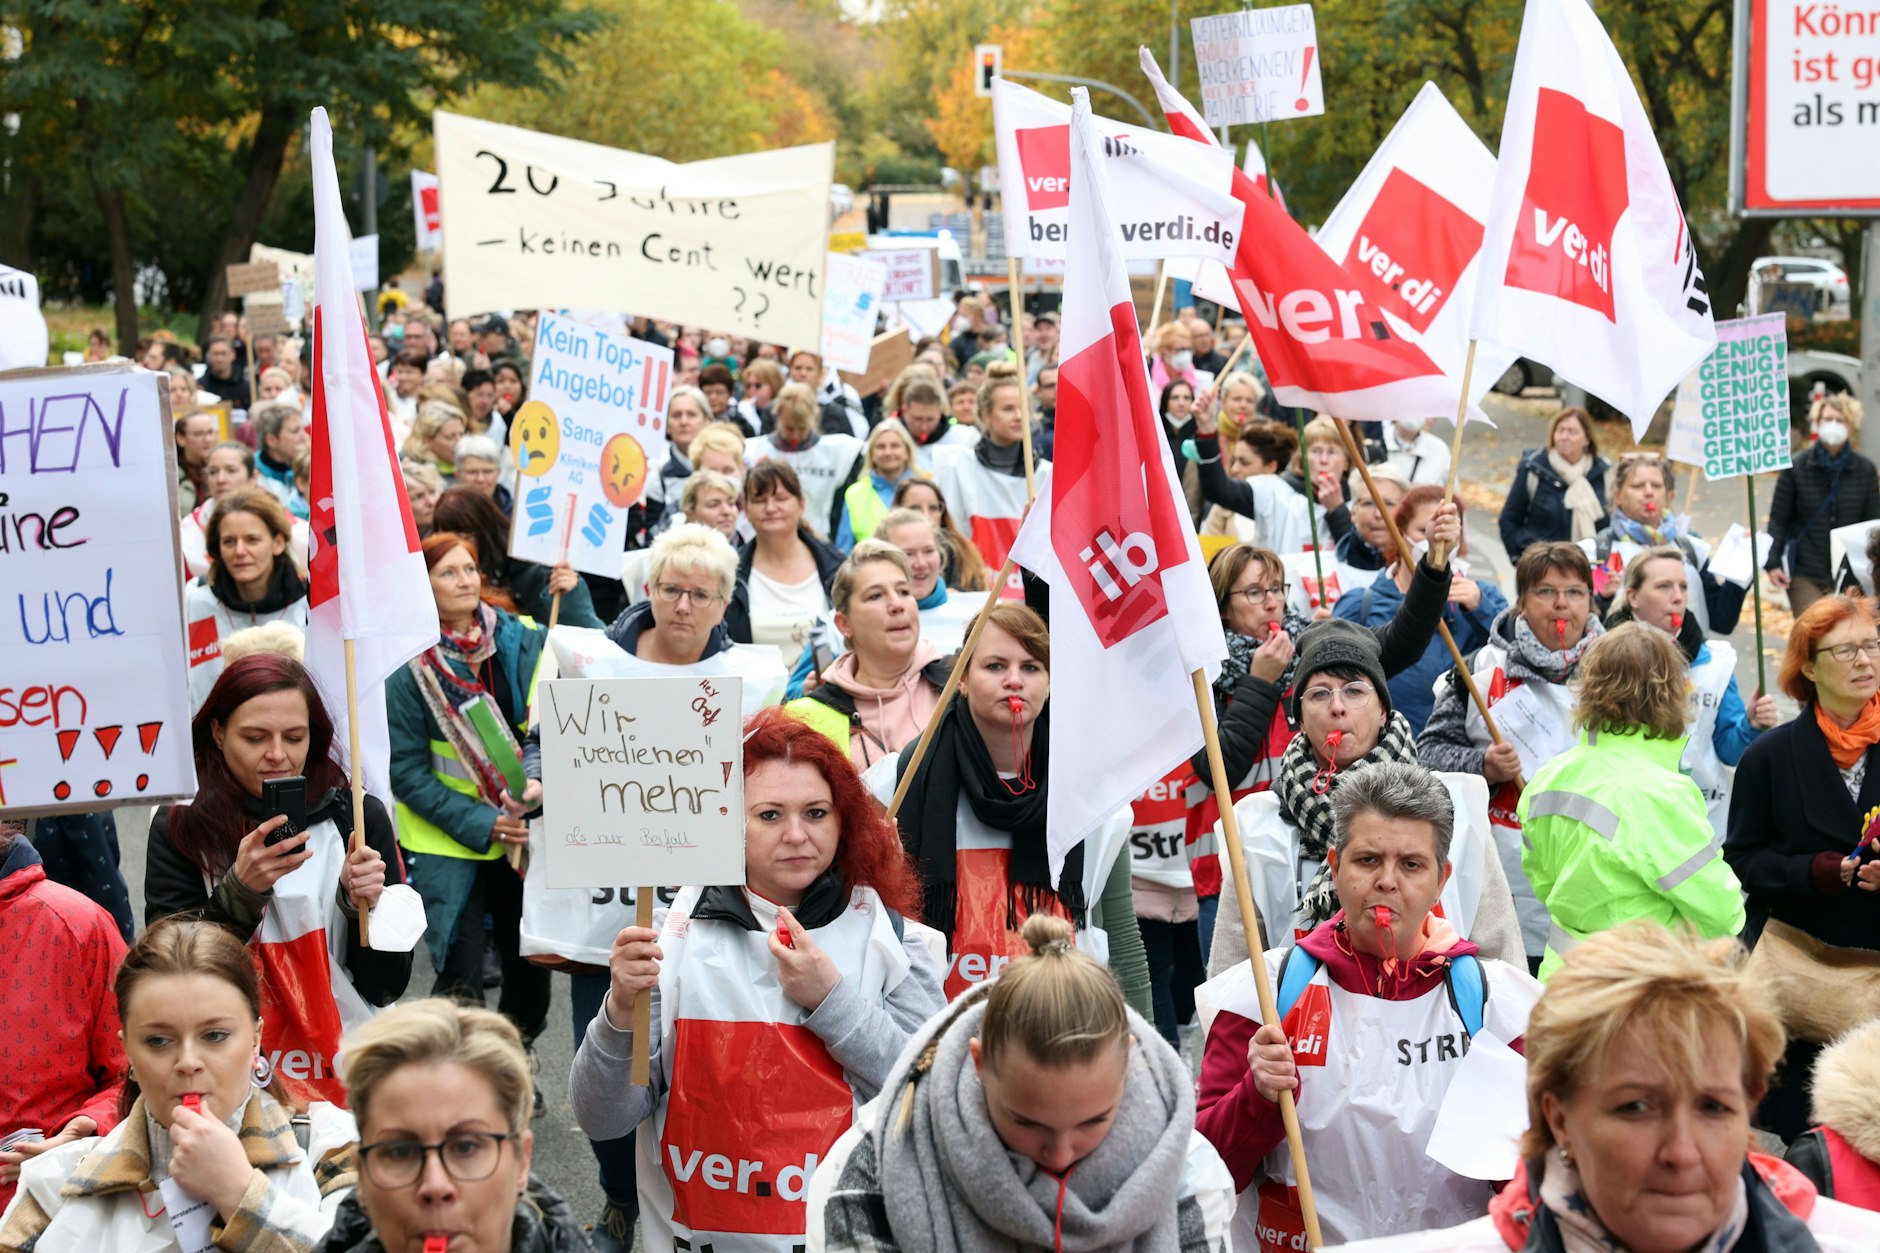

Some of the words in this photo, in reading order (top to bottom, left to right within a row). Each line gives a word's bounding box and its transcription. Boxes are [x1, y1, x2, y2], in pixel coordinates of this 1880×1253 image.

[1793, 49, 1839, 82] ist
[1852, 57, 1880, 90] g
[1794, 93, 1844, 127] als
[1120, 215, 1234, 250] verdi.de
[640, 232, 718, 272] Cent
[746, 257, 818, 299] wert
[1357, 235, 1443, 315] ver.di
[732, 287, 770, 328] ??
[538, 317, 589, 360] Kein
[595, 331, 643, 374] Top-
[1699, 354, 1773, 382] GENUG
[537, 358, 636, 411] Angebot
[1701, 373, 1774, 401] GENUG
[1702, 393, 1775, 421] GENUG
[562, 417, 604, 447] Sana
[1703, 412, 1775, 439] GENUG
[1704, 432, 1776, 459] GENUG
[559, 452, 600, 473] Kliniken
[1705, 450, 1777, 478] GENUG
[568, 470, 584, 485] AG
[19, 568, 126, 645] und
[699, 679, 721, 698] Hey
[549, 684, 636, 736] Wir
[691, 697, 722, 728] Chef
[1137, 779, 1186, 803] er.
[565, 826, 587, 844] als
[597, 833, 625, 845] nur
[640, 827, 690, 854] Beifall
[1130, 832, 1184, 860] Str
